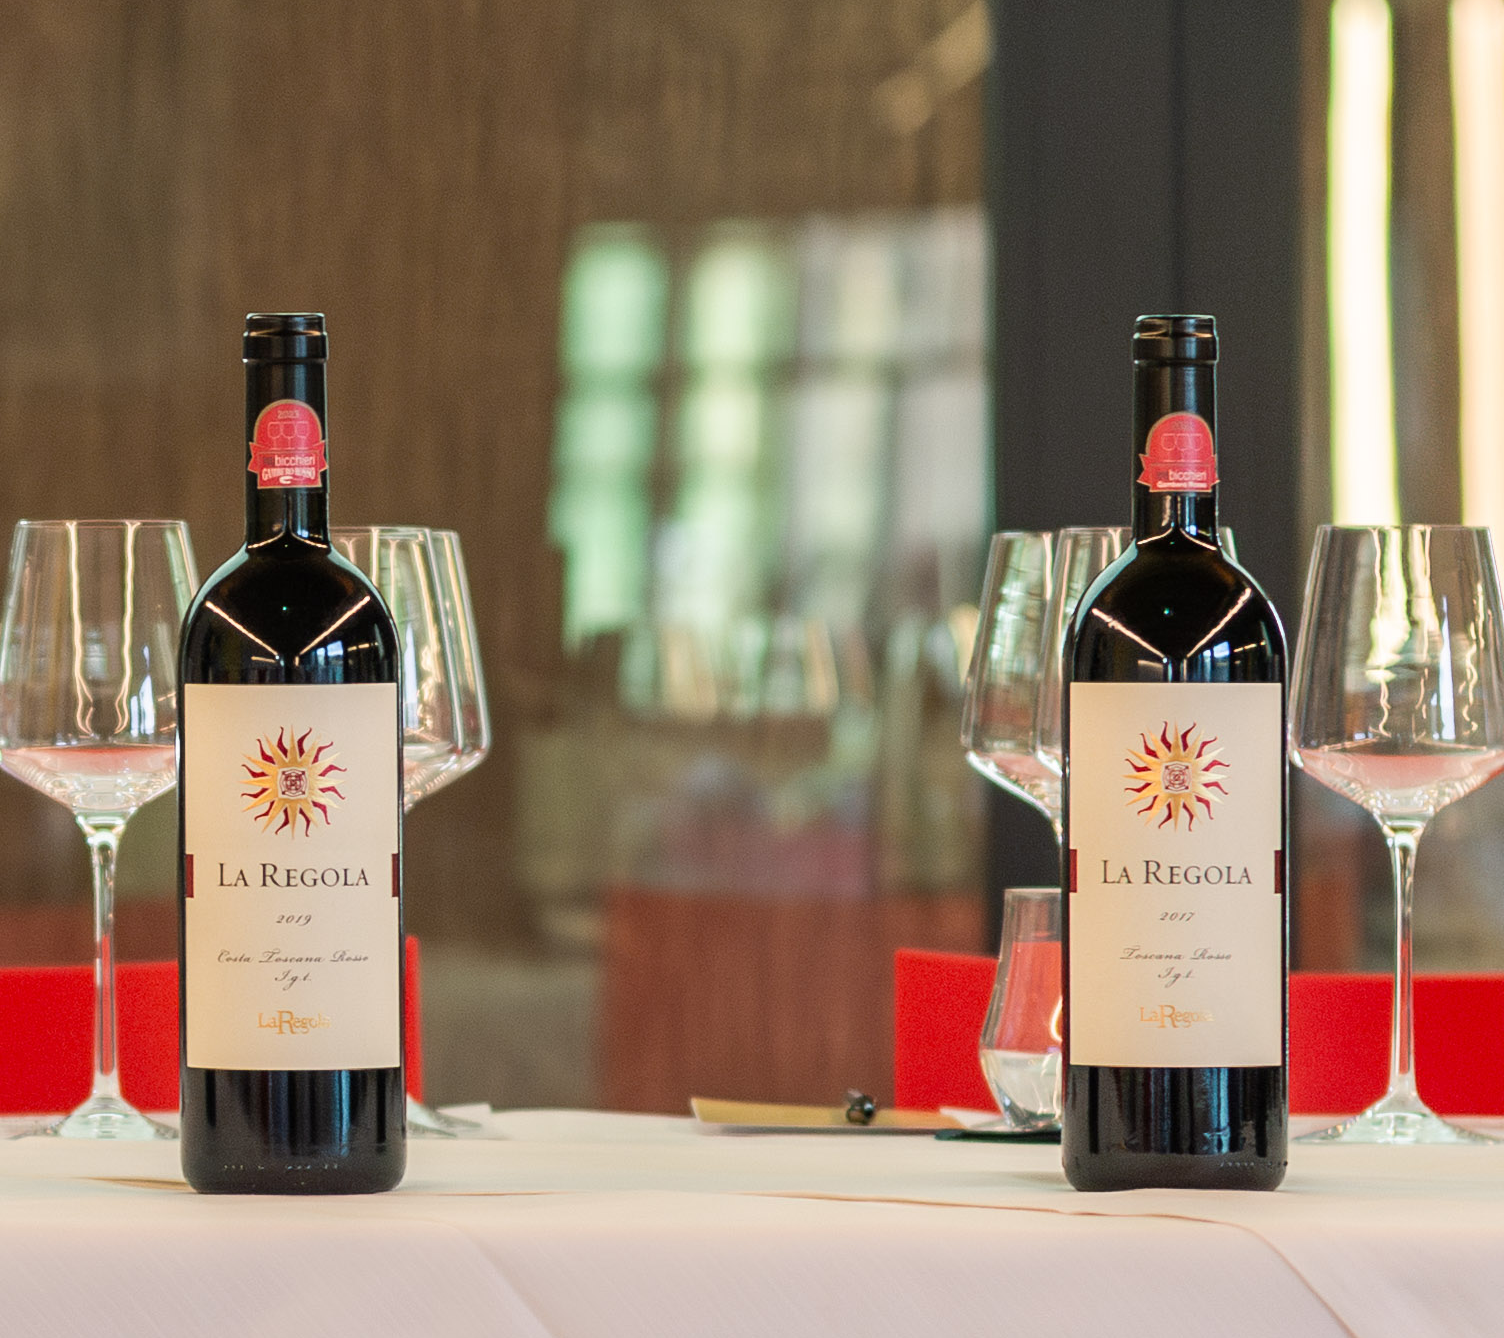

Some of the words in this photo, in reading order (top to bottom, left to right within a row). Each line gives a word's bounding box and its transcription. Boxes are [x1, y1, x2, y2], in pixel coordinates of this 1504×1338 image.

[218, 862, 248, 887] LA
[260, 862, 370, 888] REGOLA
[1101, 859, 1133, 884] LA
[1143, 860, 1253, 885] REGOLA
[276, 914, 312, 927] 2019
[1159, 911, 1196, 922] 2017
[217, 949, 252, 963] Costa
[258, 947, 322, 963] Toscana
[330, 950, 369, 963] Rosso
[1120, 945, 1183, 960] Toscana
[1190, 947, 1232, 960] Rosso
